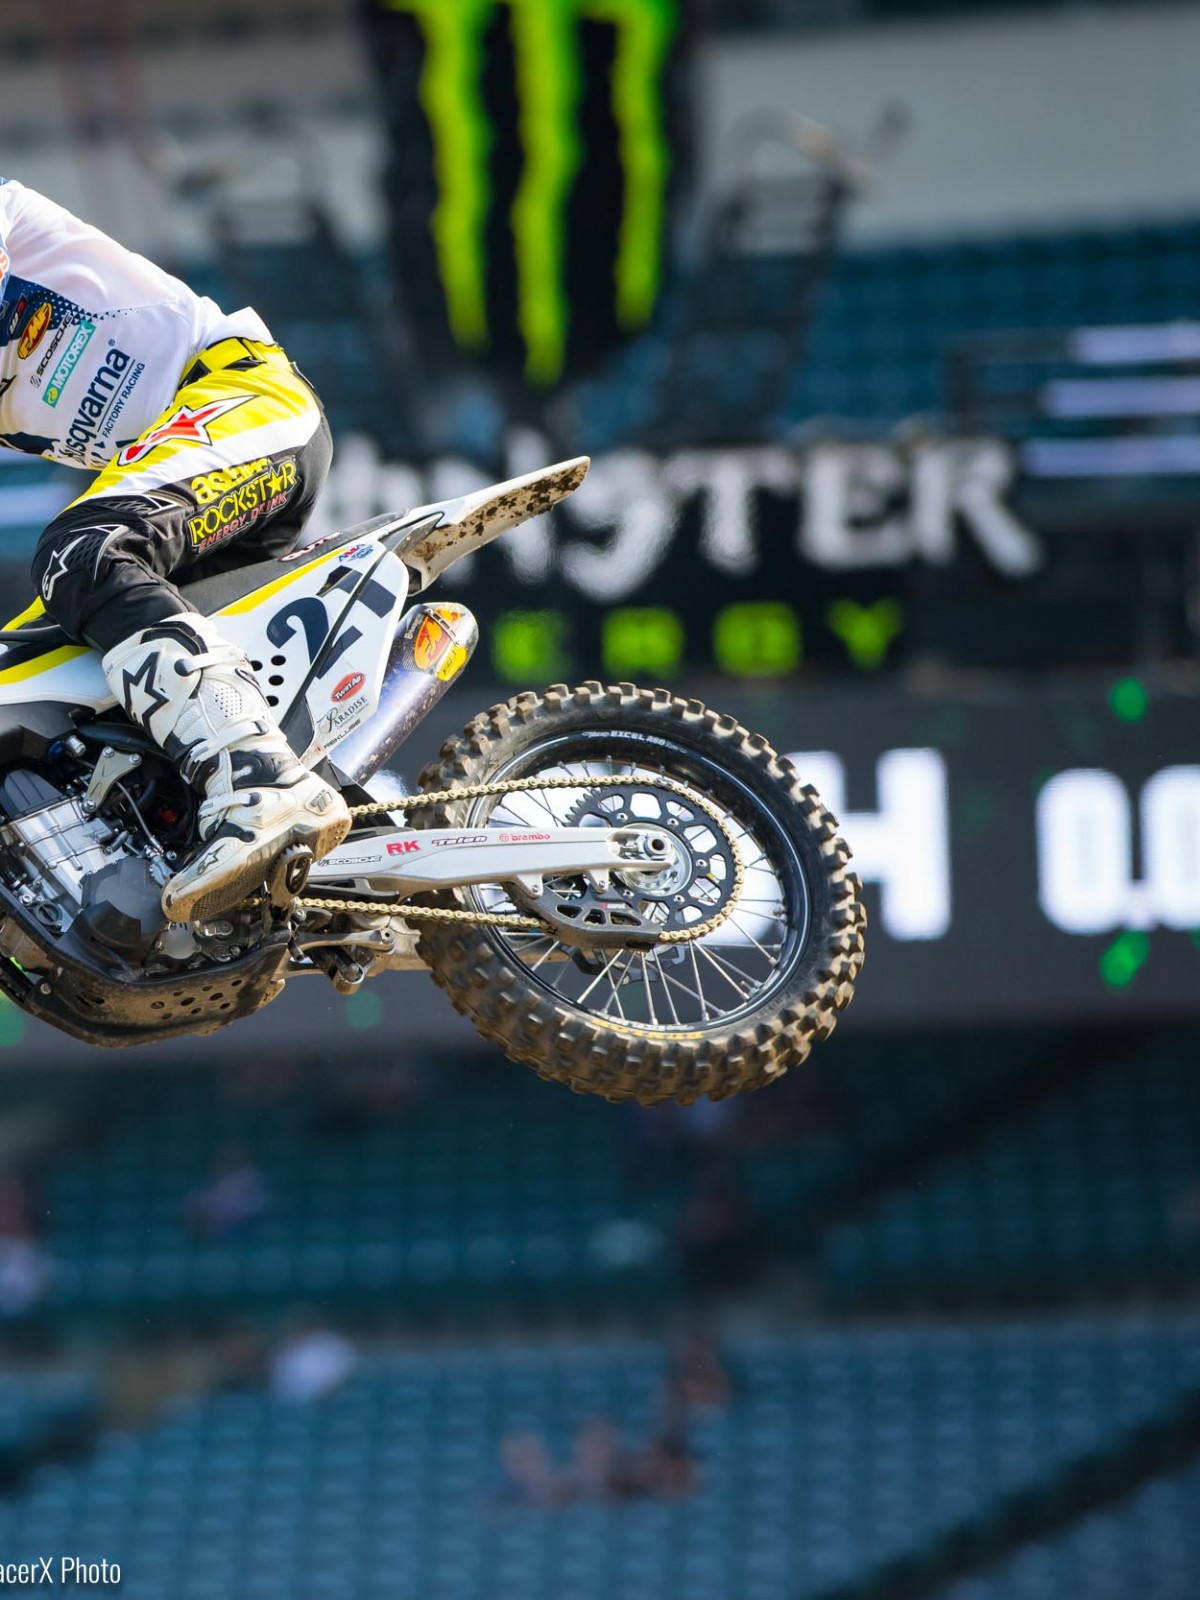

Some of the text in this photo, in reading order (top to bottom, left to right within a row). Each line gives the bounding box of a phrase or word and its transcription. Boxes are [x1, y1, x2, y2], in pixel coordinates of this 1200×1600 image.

[50, 323, 93, 390] MOTOREX
[102, 362, 146, 438] FACTORY RACING
[200, 514, 247, 550] ENERGY
[267, 565, 398, 680] 21
[334, 673, 364, 701] Twin Air
[610, 730, 645, 741] EXCEL
[387, 840, 421, 855] RK
[511, 833, 551, 842] brembo
